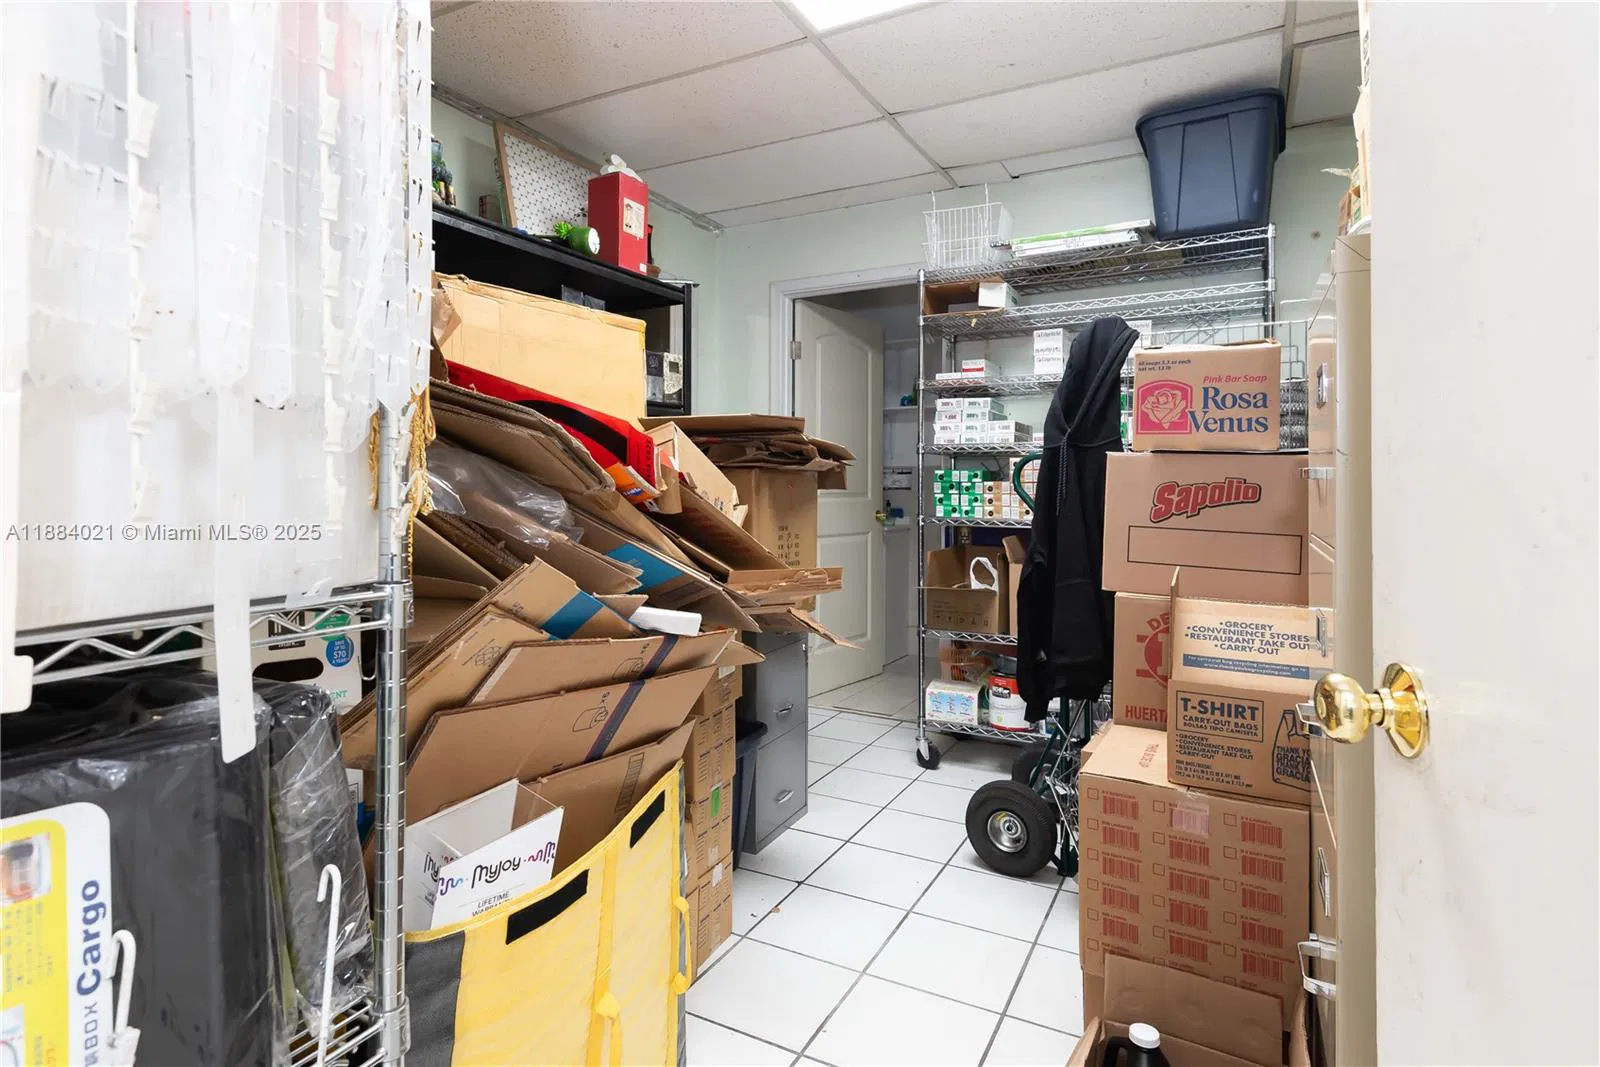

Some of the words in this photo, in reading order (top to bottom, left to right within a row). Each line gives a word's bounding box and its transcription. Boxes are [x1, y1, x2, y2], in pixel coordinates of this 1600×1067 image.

[1203, 375, 1223, 384] Pink
[1225, 375, 1241, 383] Bar
[1243, 374, 1267, 384] Soap
[1201, 386, 1268, 410] Rosa
[1188, 410, 1269, 433] Venus
[1150, 477, 1261, 523] Sapolio
[1192, 625, 1266, 639] CONVENIENCE
[1269, 633, 1310, 643] STORES
[1225, 620, 1274, 632] GROCERY
[1190, 632, 1256, 646] RESTAURANT
[1260, 640, 1286, 648] TAKE
[1220, 643, 1280, 655] CARRY-OUT
[1180, 697, 1259, 721] T-SHIRT
[1183, 714, 1232, 727] CARRY-OUT
[1234, 722, 1259, 731] BAGS
[1183, 721, 1208, 731] BOLSAS
[1226, 727, 1258, 737] CAMISETA
[1179, 733, 1209, 742] GROCERY
[1179, 739, 1225, 750] CONVENIENCE
[1227, 745, 1252, 754] STORES
[1179, 744, 1220, 756] RESTAURANT
[1221, 750, 1238, 758] TAKE
[1239, 752, 1254, 760] OUT
[1277, 746, 1300, 755] THANK
[1179, 750, 1216, 760] CARRY-OUT
[477, 891, 510, 908] LIFETIME
[76, 880, 107, 996] Cargo
